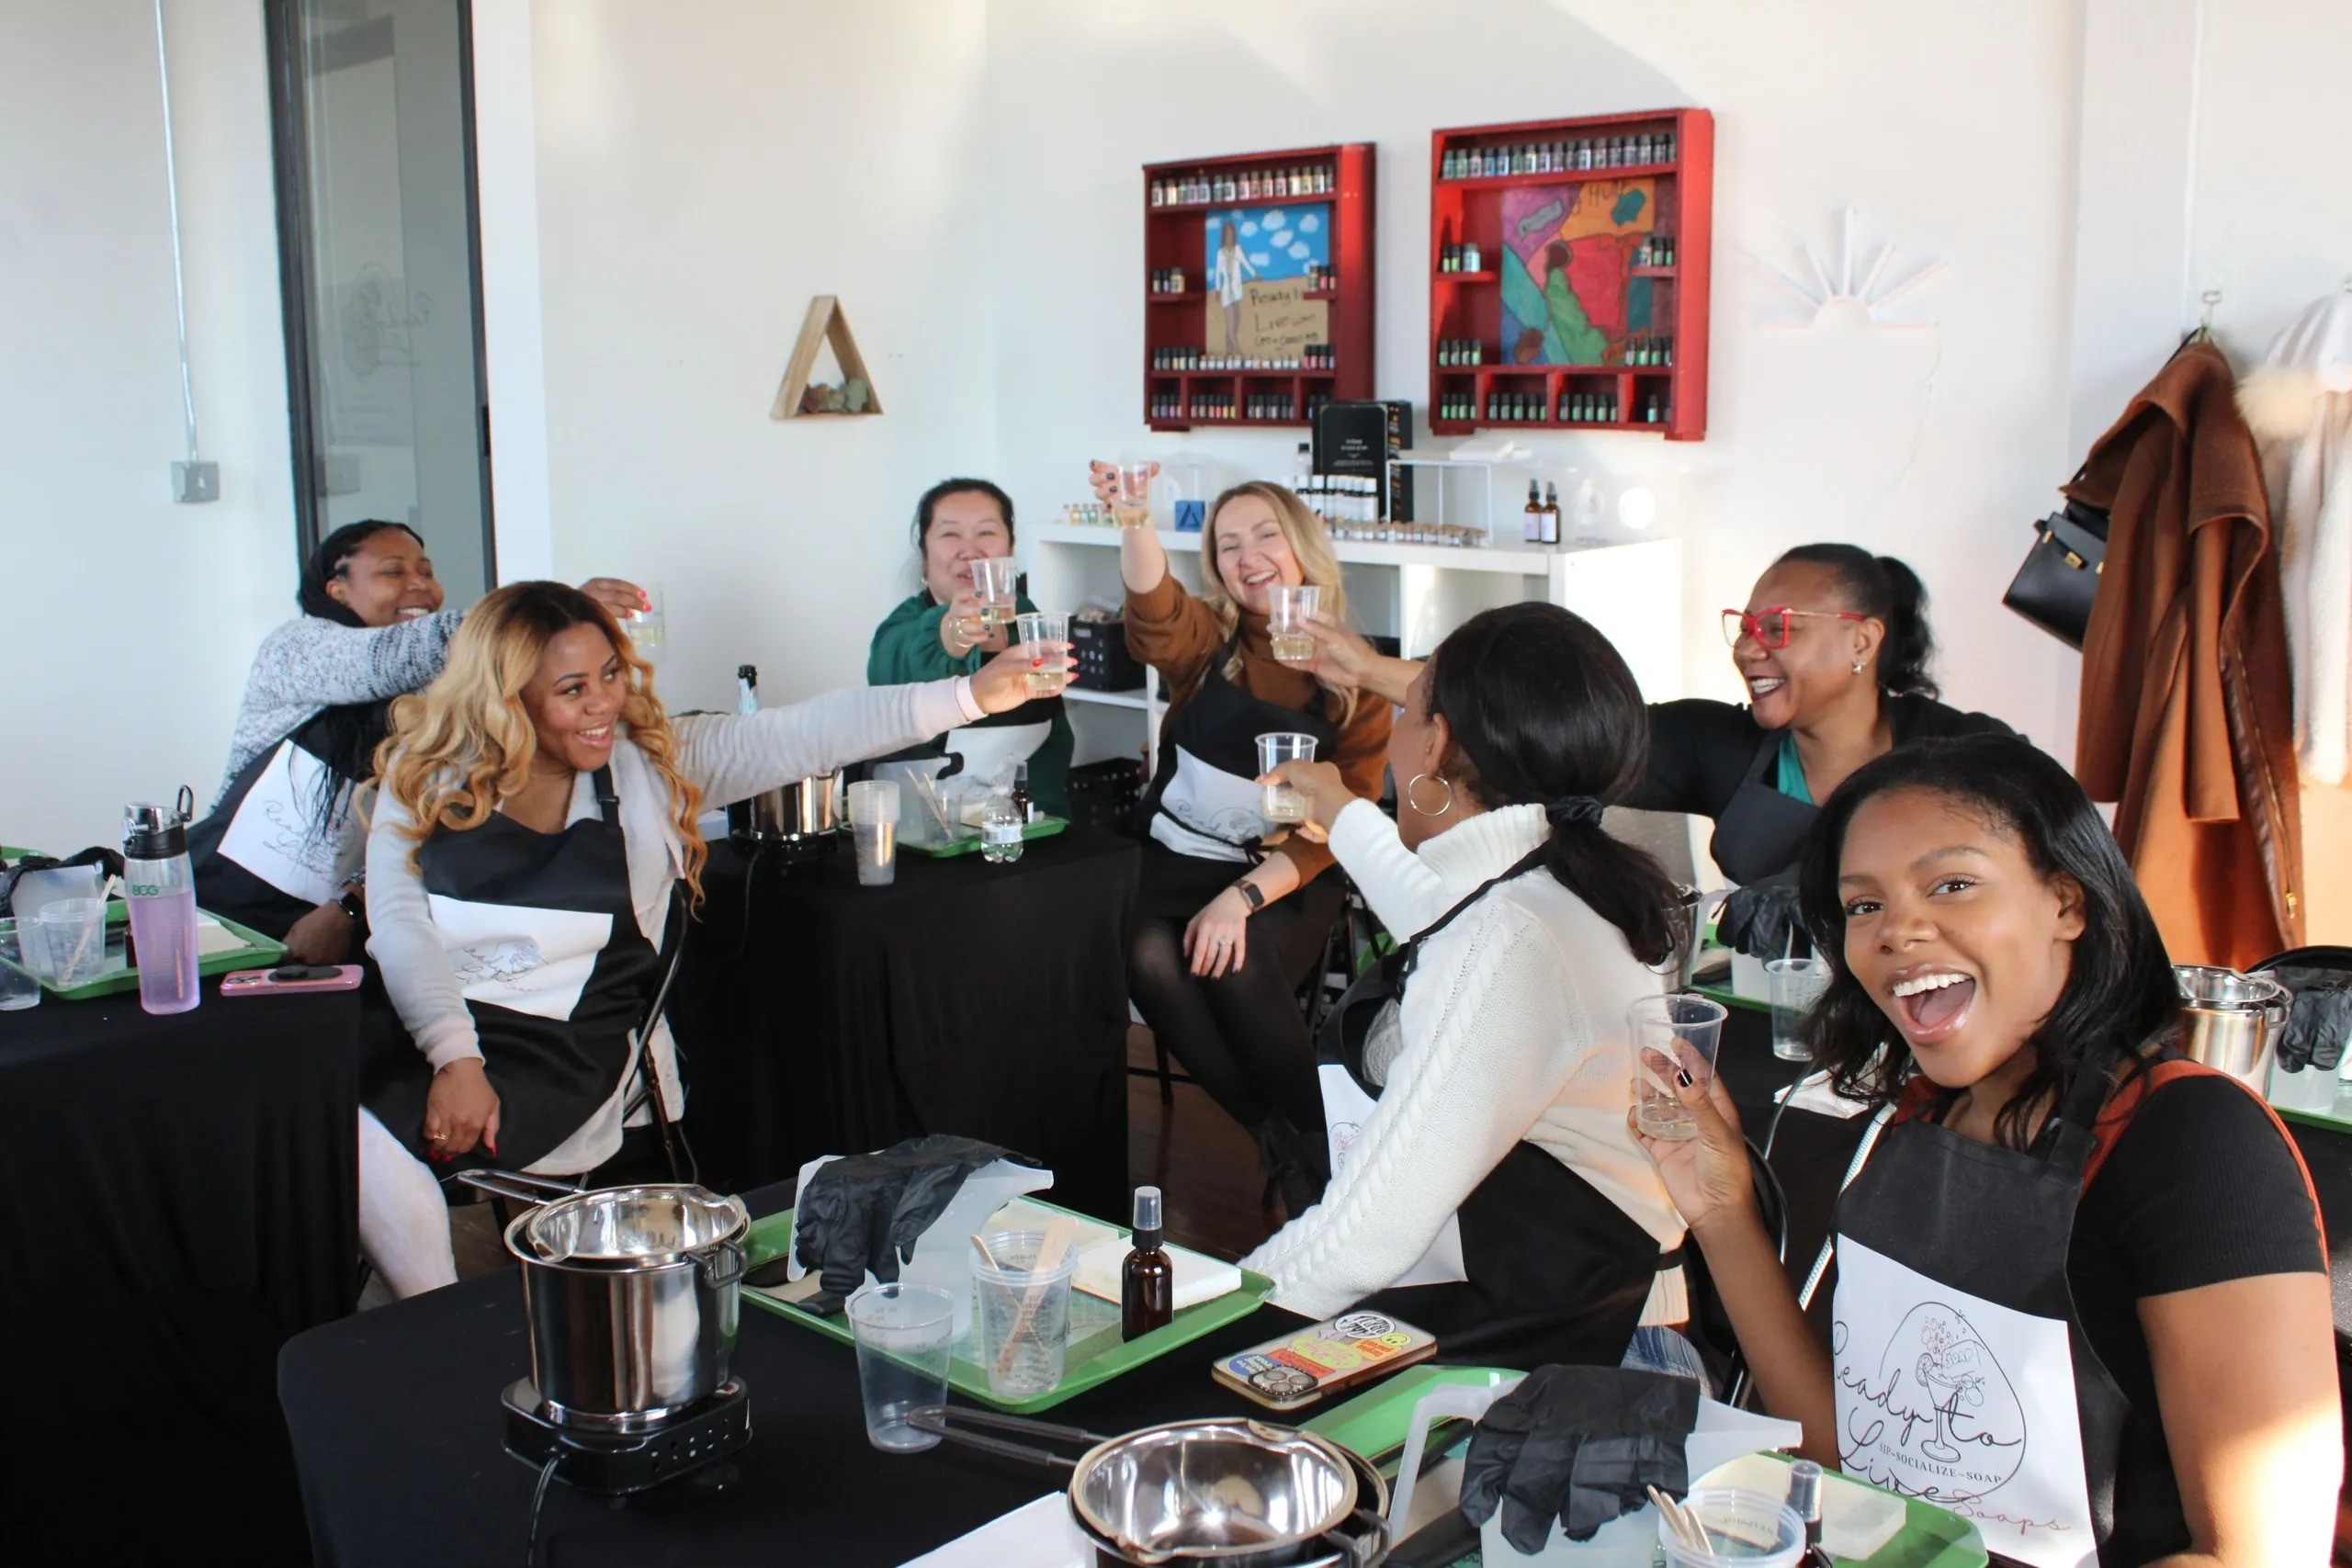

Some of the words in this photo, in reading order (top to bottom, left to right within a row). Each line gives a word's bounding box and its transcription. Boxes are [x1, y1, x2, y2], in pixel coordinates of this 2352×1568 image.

[1946, 1348, 1973, 1369] SOAP
[1934, 1392, 2022, 1447] to
[1952, 1489, 2071, 1536] Soaps
